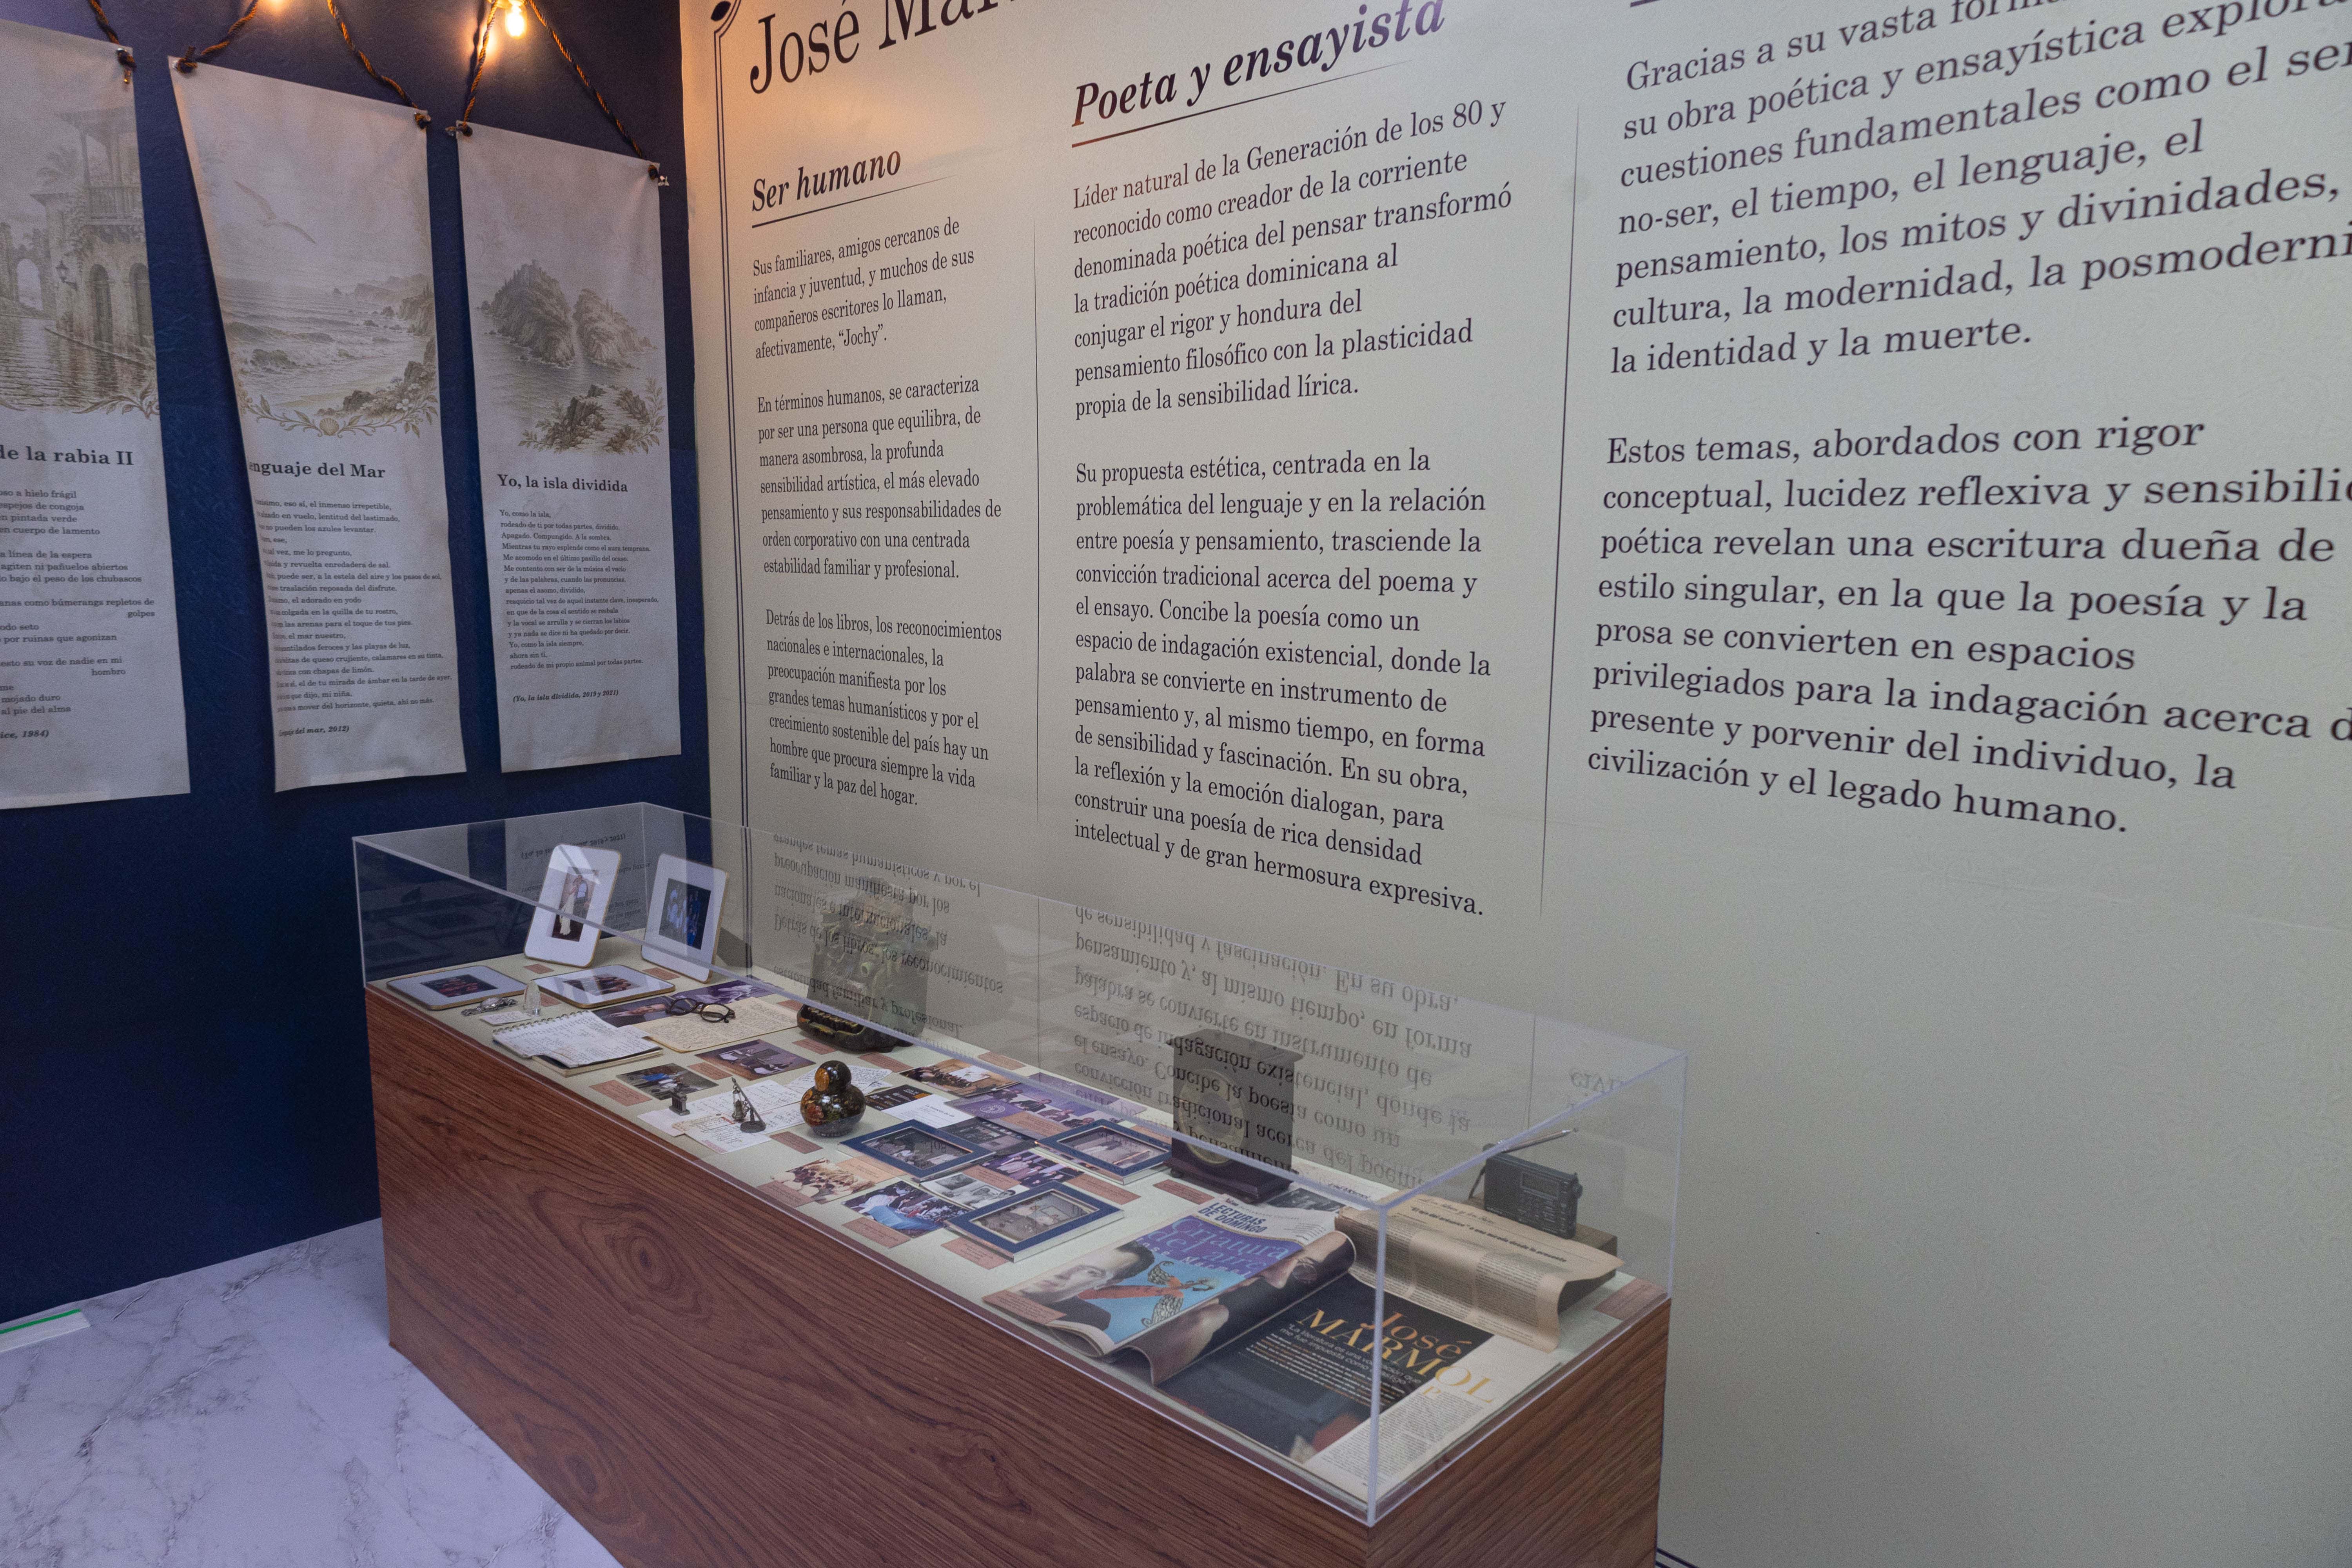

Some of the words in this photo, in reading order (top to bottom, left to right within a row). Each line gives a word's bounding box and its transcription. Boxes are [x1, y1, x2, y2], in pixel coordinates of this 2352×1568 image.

[750, 0, 859, 94] José
[1072, 72, 1177, 127] Poeta
[1187, 63, 1210, 107] y
[1223, 0, 1444, 86] ensayista
[1627, 47, 1745, 90] Gracias
[1757, 43, 1774, 64] a
[1788, 31, 1825, 58] su
[1839, 7, 1936, 45] vasta
[1074, 183, 1118, 209] Líder
[1124, 163, 1188, 198] natural
[1195, 159, 1216, 182] de
[1223, 154, 1239, 176] la
[1247, 126, 1367, 170] Generación
[1376, 118, 1402, 143] de
[1411, 112, 1443, 136] los
[1453, 100, 1482, 128] 80
[1490, 102, 1506, 127] y
[752, 179, 789, 211] Ser
[797, 151, 900, 200] humano
[753, 260, 772, 276] Sus
[775, 249, 834, 272] familiares,
[838, 238, 881, 259] amigos
[884, 226, 940, 249] cercanos
[944, 216, 959, 236] de
[755, 310, 818, 332] compañeros
[821, 299, 879, 320] escritores
[882, 292, 894, 310] lo
[897, 289, 946, 308] llaman,
[756, 335, 835, 359] afectivamente,
[838, 323, 887, 347] “Jochy”.
[758, 397, 772, 413] En
[775, 393, 824, 411] términos
[827, 389, 885, 406] humanos,
[889, 388, 902, 400] se
[906, 375, 979, 398] caracteriza
[1076, 393, 1126, 420] propia
[1132, 390, 1151, 411] de
[1156, 388, 1172, 409] la
[1178, 376, 1290, 407] sensibilidad
[1298, 373, 1358, 397] lírica.
[26, 446, 46, 461] la
[54, 449, 110, 464] rabia
[117, 451, 133, 465] II
[1608, 437, 1684, 463] Estos
[1696, 438, 1799, 463] temas,
[1813, 423, 1999, 457] abordados
[2013, 429, 2080, 451] con
[2096, 416, 2205, 456] rigor
[318, 463, 345, 476] del
[350, 464, 385, 478] Mar
[497, 474, 521, 488] Yo,
[526, 475, 539, 488] la
[544, 477, 568, 489] isla
[572, 478, 628, 492] dividida
[1076, 463, 1096, 483] Su
[1102, 462, 1184, 486] propuesta
[1190, 456, 1265, 479] estética,
[1273, 450, 1365, 475] centrada
[1374, 456, 1400, 472] en
[1409, 447, 1430, 470] la
[1603, 480, 1771, 514] conceptual,
[1785, 477, 1906, 507] lucidez
[1918, 475, 2089, 506] reflexiva
[2103, 483, 2131, 512] y
[764, 557, 820, 574] estabilidad
[824, 558, 871, 575] familiar
[874, 564, 881, 580] y
[885, 559, 959, 580] profesional.
[766, 609, 800, 626] Detrás
[802, 612, 815, 628] de
[818, 612, 833, 629] los
[836, 613, 872, 634] libros,
[876, 615, 893, 633] los
[897, 620, 1002, 641] reconocimientos
[770, 762, 811, 784] familiar
[814, 775, 820, 789] y
[824, 772, 833, 789] la
[837, 780, 857, 794] paz
[860, 779, 877, 797] del
[880, 782, 917, 806] hogar.
[1588, 746, 1749, 787] civilización
[1759, 772, 1779, 796] y
[1789, 768, 1815, 795] el
[1828, 770, 1941, 809] legado
[1953, 784, 2126, 832] humano.
[1075, 819, 1159, 852] intelectual
[1165, 842, 1175, 859] y
[1181, 838, 1200, 860] de
[1206, 849, 1247, 869] gran
[1254, 851, 1361, 891] hermosura
[1369, 880, 1483, 915] expresiva.
[1198, 1207, 1218, 1217] DE
[1209, 1202, 1266, 1225] LECTURAS
[1147, 1230, 1217, 1253] del
[1172, 1218, 1289, 1261] Criatura
[1360, 1312, 1472, 1359] José
